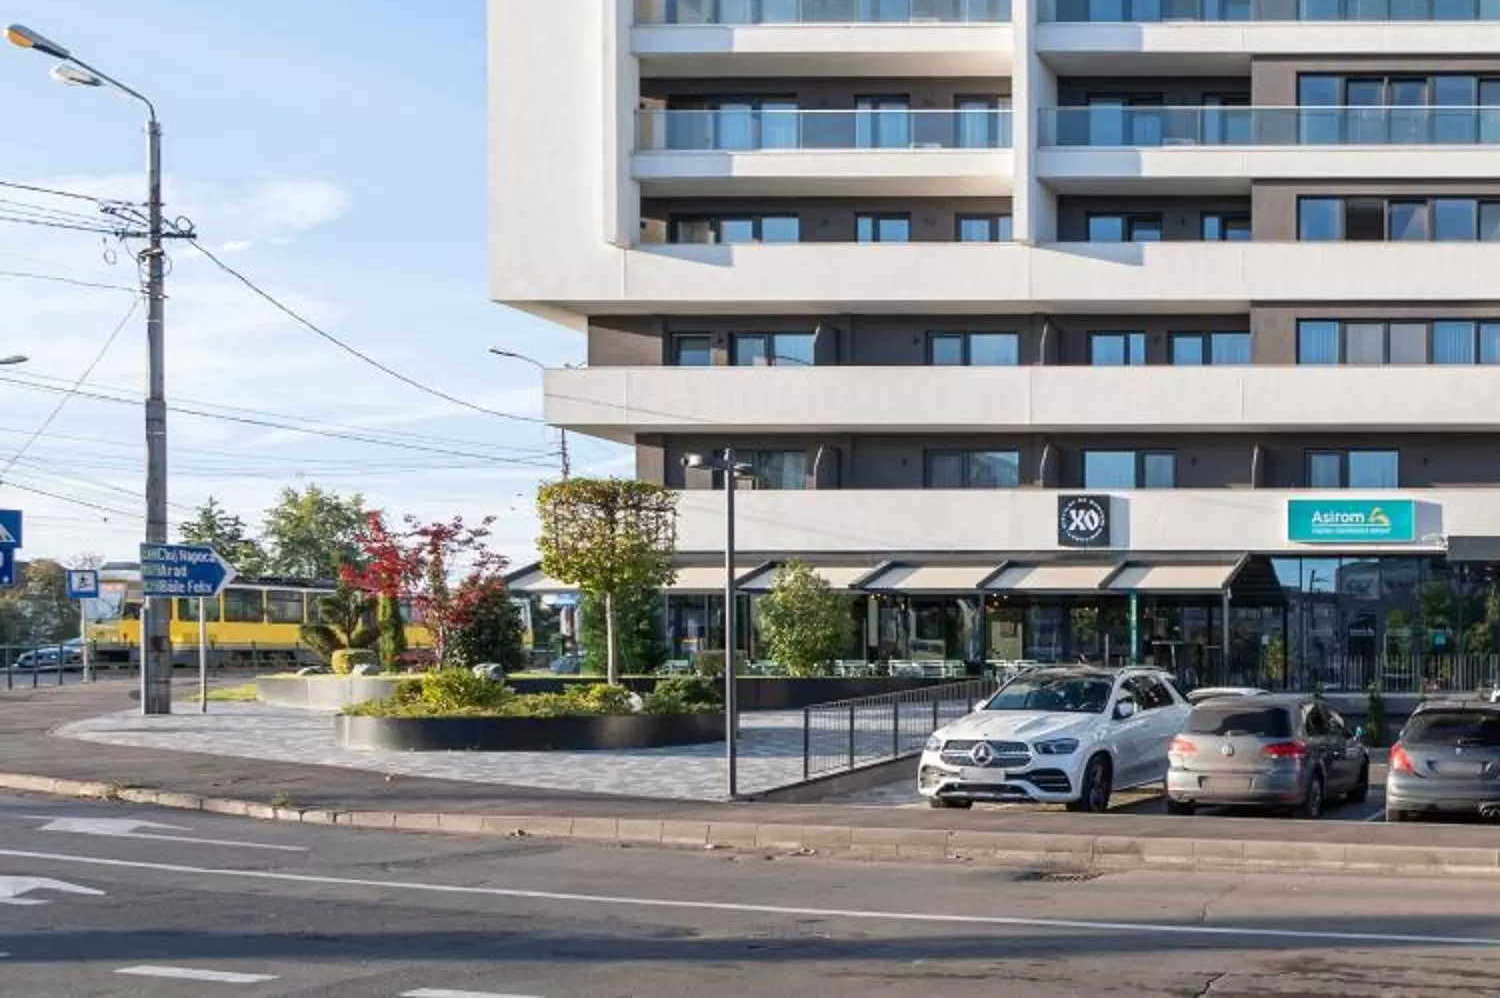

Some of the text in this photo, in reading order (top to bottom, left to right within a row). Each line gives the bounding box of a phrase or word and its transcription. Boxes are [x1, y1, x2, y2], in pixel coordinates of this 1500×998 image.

[1068, 509, 1099, 531] XO
[1311, 509, 1365, 523] Asirom
[158, 564, 187, 577] Arad
